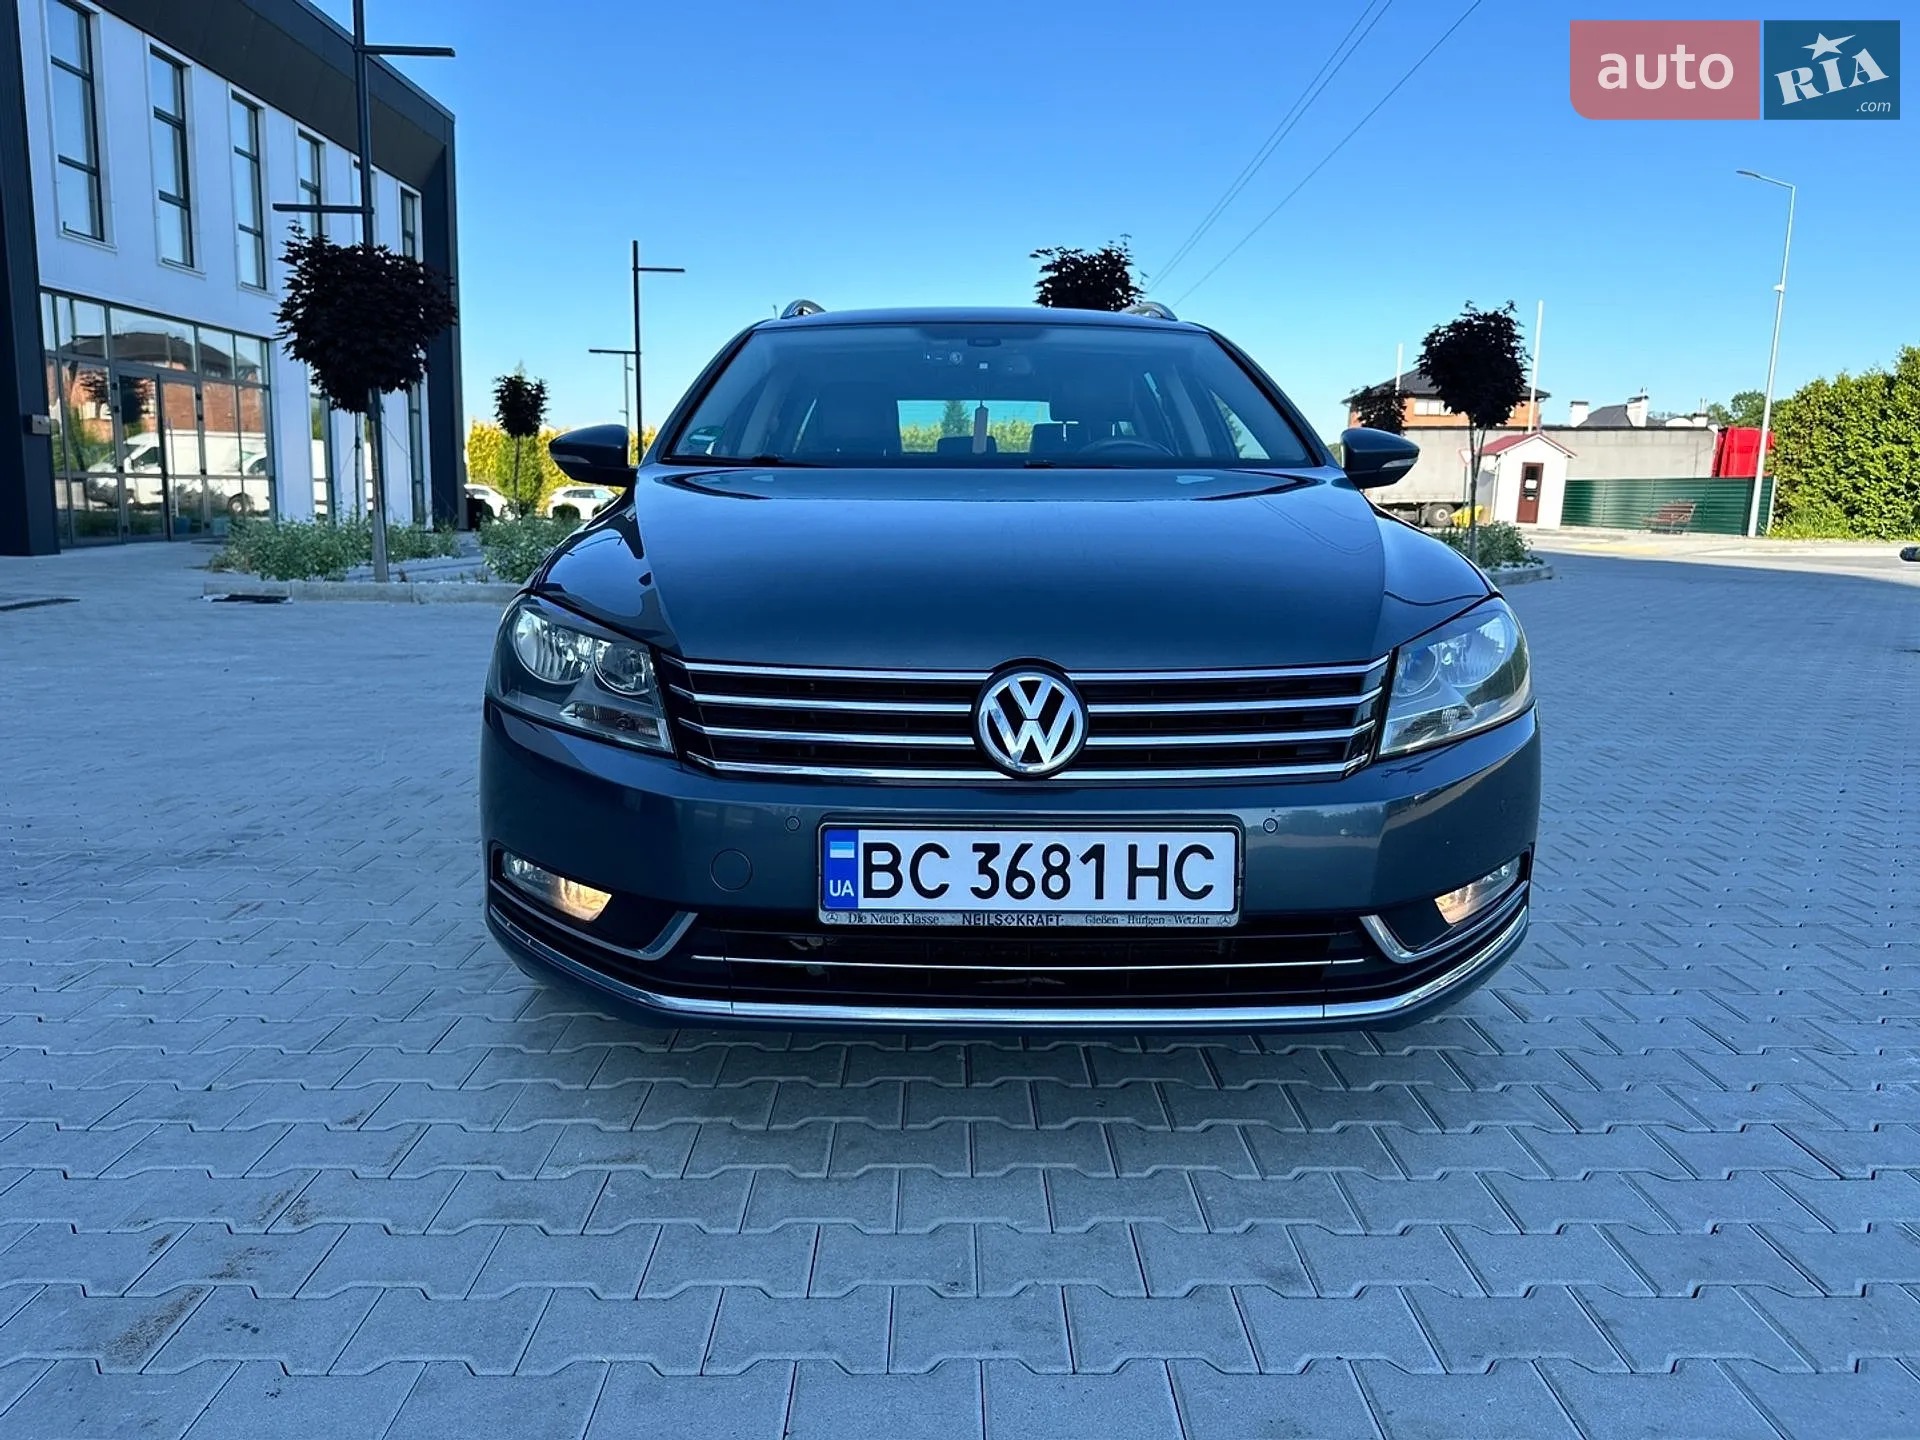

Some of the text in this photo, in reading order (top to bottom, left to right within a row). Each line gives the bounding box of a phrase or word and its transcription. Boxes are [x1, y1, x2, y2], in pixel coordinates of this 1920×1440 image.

[862, 842, 1216, 901] BC 3681 HC
[829, 879, 855, 897] UA
[849, 913, 867, 925] Die
[870, 913, 900, 925] Neue
[902, 913, 940, 925] Klasse
